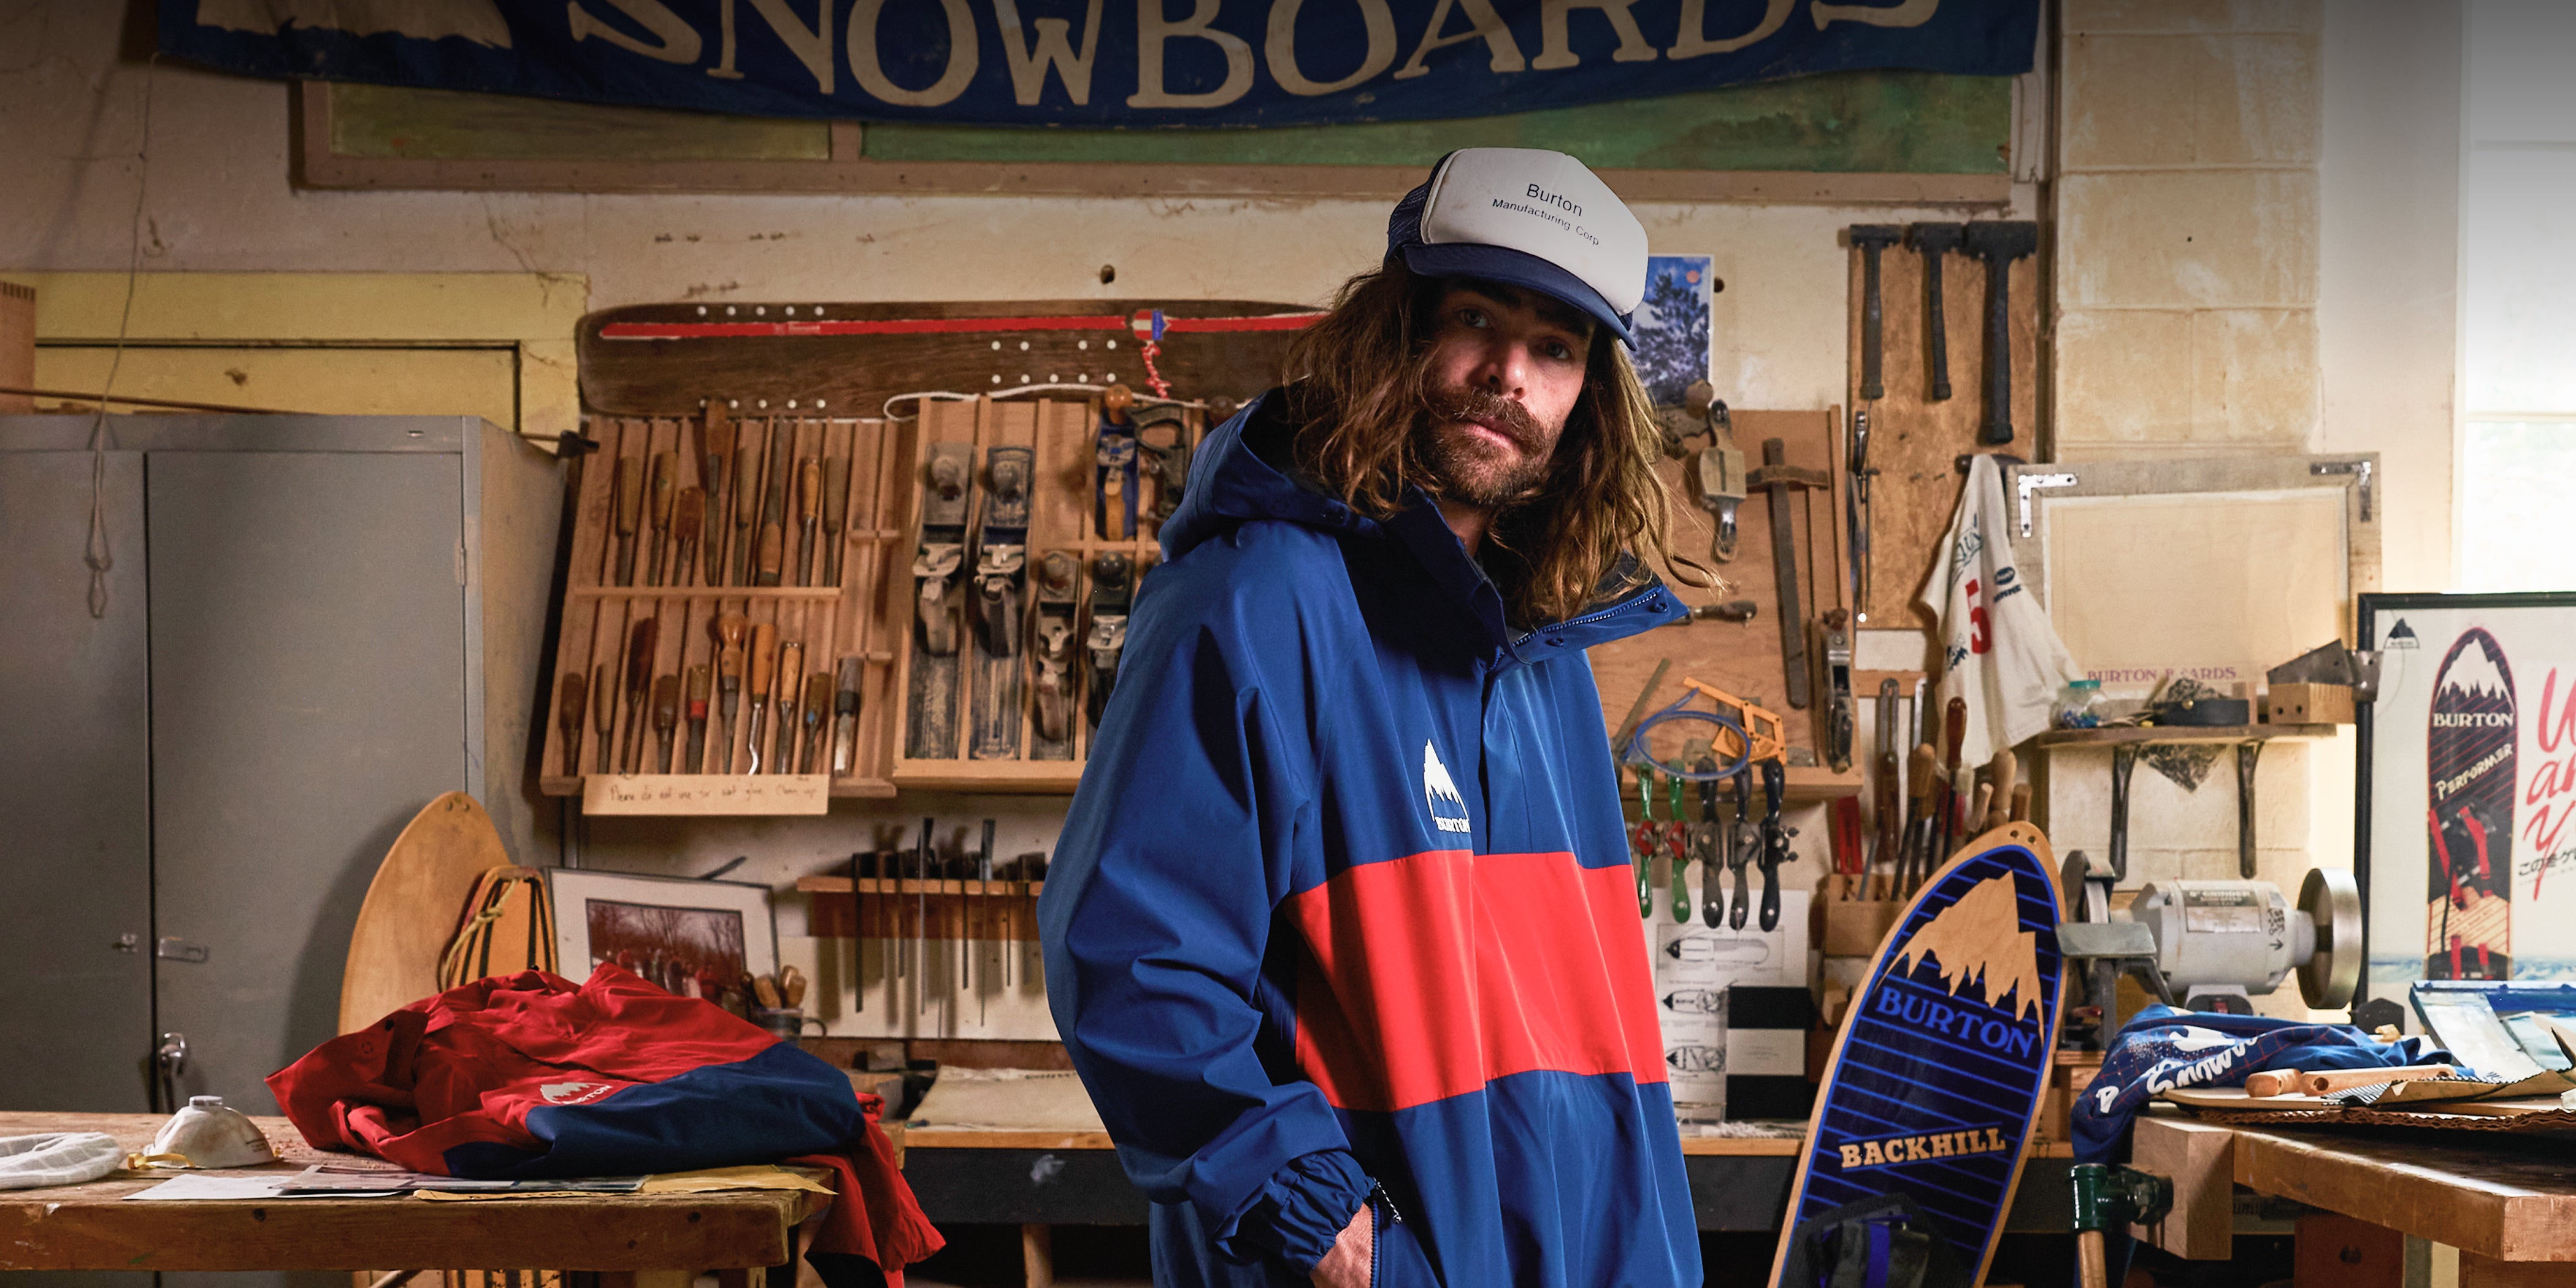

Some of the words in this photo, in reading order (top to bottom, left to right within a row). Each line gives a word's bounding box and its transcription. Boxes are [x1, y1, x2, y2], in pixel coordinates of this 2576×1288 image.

[567, 0, 1941, 109] SNOWBOARD
[1492, 199, 1571, 231] Manufacturing
[1526, 183, 1582, 217] Burton
[2087, 667, 2157, 683] BURTON
[2164, 666, 2237, 680] BARDS
[2432, 712, 2513, 727] BURTON
[1435, 816, 1471, 833] BURTON
[1876, 986, 2037, 1059] BURTON
[1839, 1128, 2007, 1168] BACKHILL
